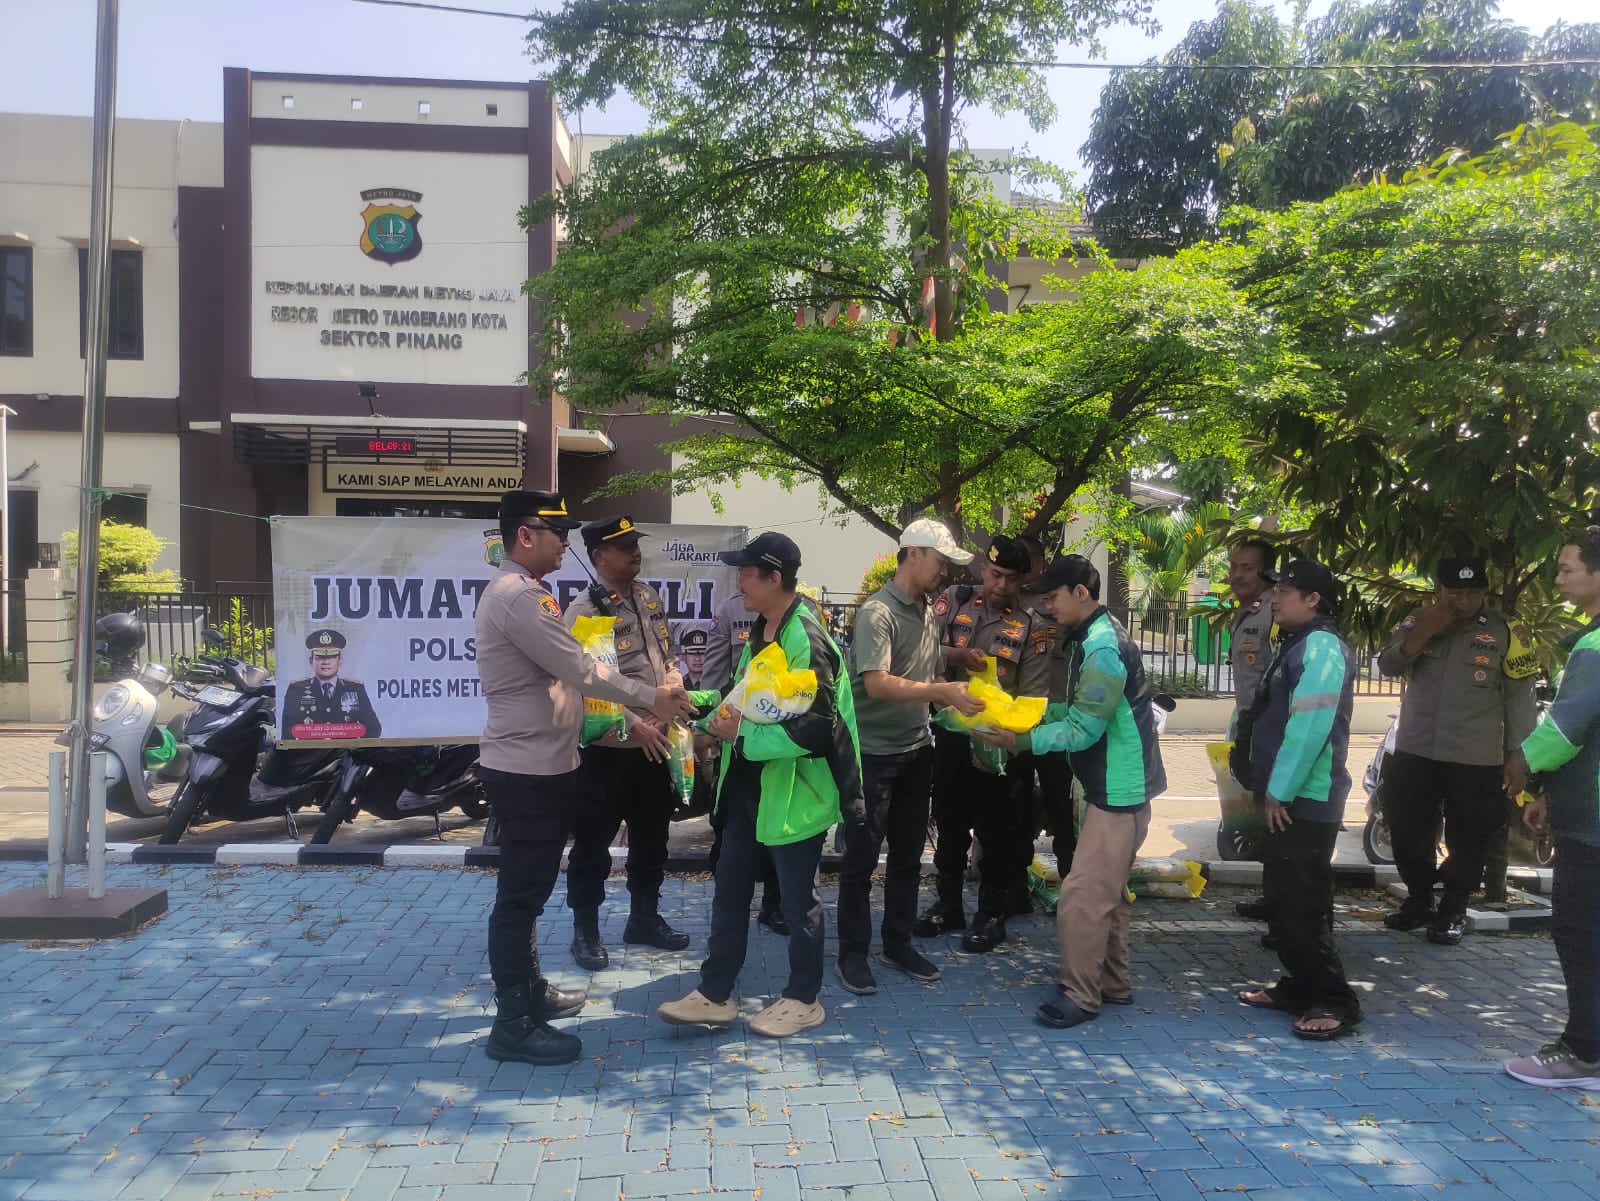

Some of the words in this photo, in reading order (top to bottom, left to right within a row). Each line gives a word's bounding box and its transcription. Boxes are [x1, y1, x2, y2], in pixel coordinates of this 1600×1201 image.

[383, 309, 466, 329] TANGERANG
[472, 312, 508, 330] KOTA
[320, 330, 390, 348] SEKTOR
[396, 332, 462, 350] PINANG
[338, 474, 374, 486] KAMI
[378, 475, 410, 487] SIAP
[414, 476, 485, 488] MELAYANI
[487, 477, 523, 489] ANDA
[378, 679, 442, 699] POLRES
[447, 678, 487, 698] MET
